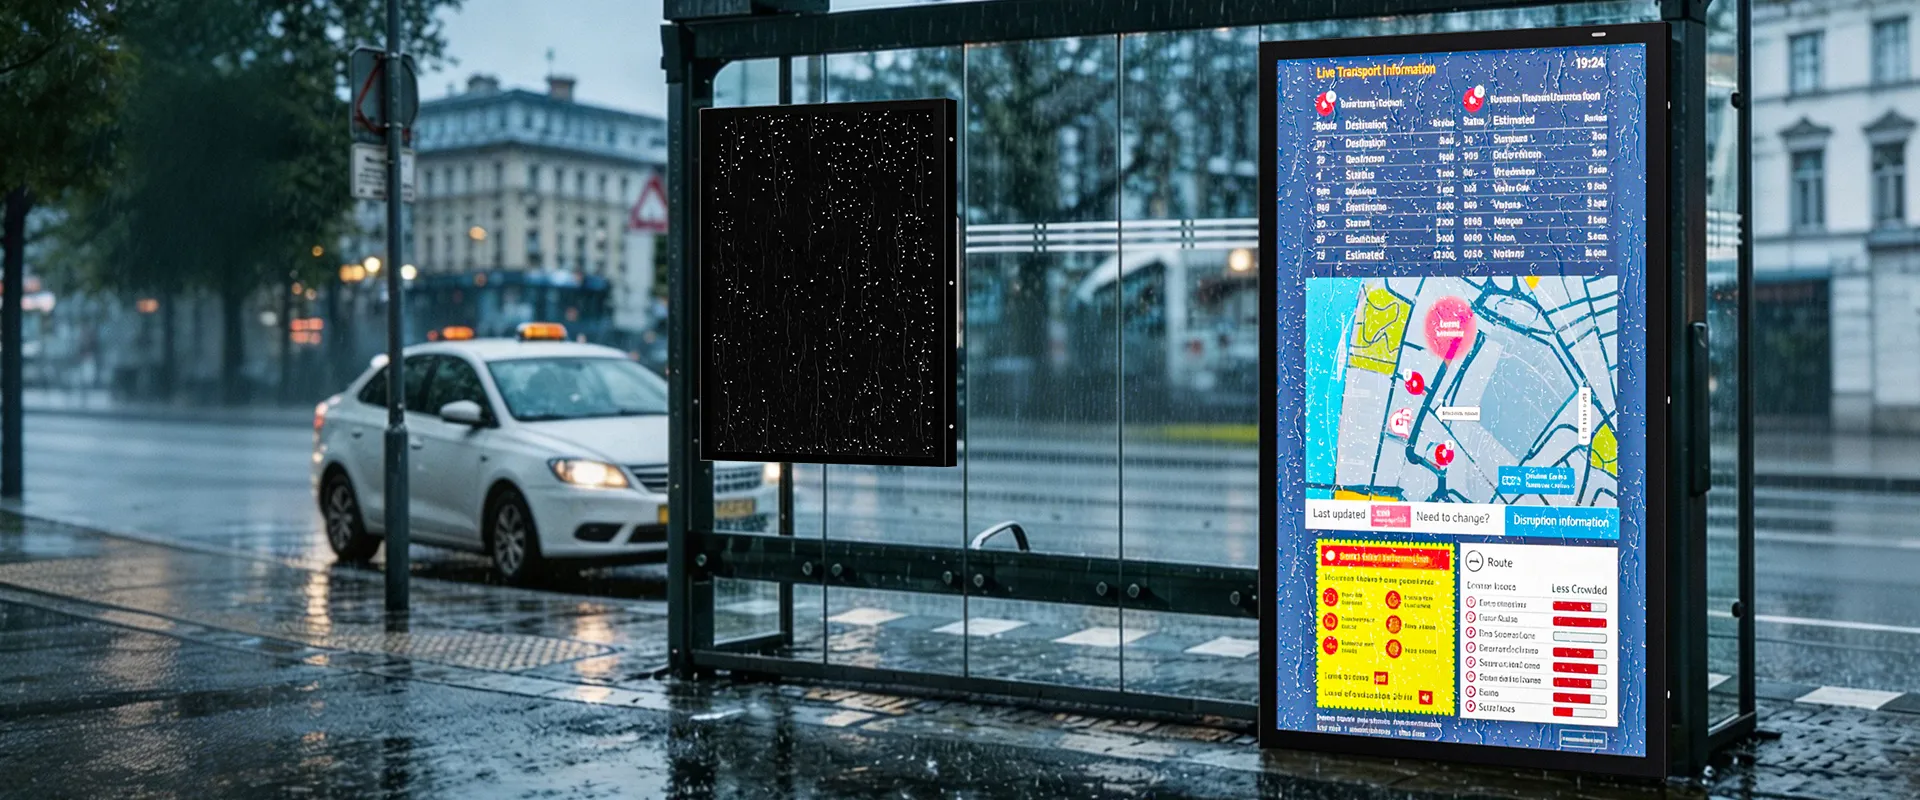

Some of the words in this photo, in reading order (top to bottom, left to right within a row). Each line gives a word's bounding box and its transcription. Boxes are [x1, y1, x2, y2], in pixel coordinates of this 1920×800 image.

[1576, 57, 1604, 69] 19:24
[1316, 66, 1335, 79] Live
[1337, 65, 1381, 79] Transport
[1383, 64, 1436, 76] Information
[1316, 121, 1337, 131] Route
[1493, 115, 1535, 125] Estimated
[1345, 250, 1384, 260] Estimated
[1313, 508, 1331, 519] Last
[1332, 509, 1366, 520] updated
[1416, 511, 1440, 522] Need
[1441, 512, 1451, 522] to
[1452, 513, 1490, 525] change?
[1559, 515, 1610, 528] information
[1487, 557, 1513, 568] Route
[1552, 584, 1570, 595] Less
[1571, 584, 1608, 596] Crowded
